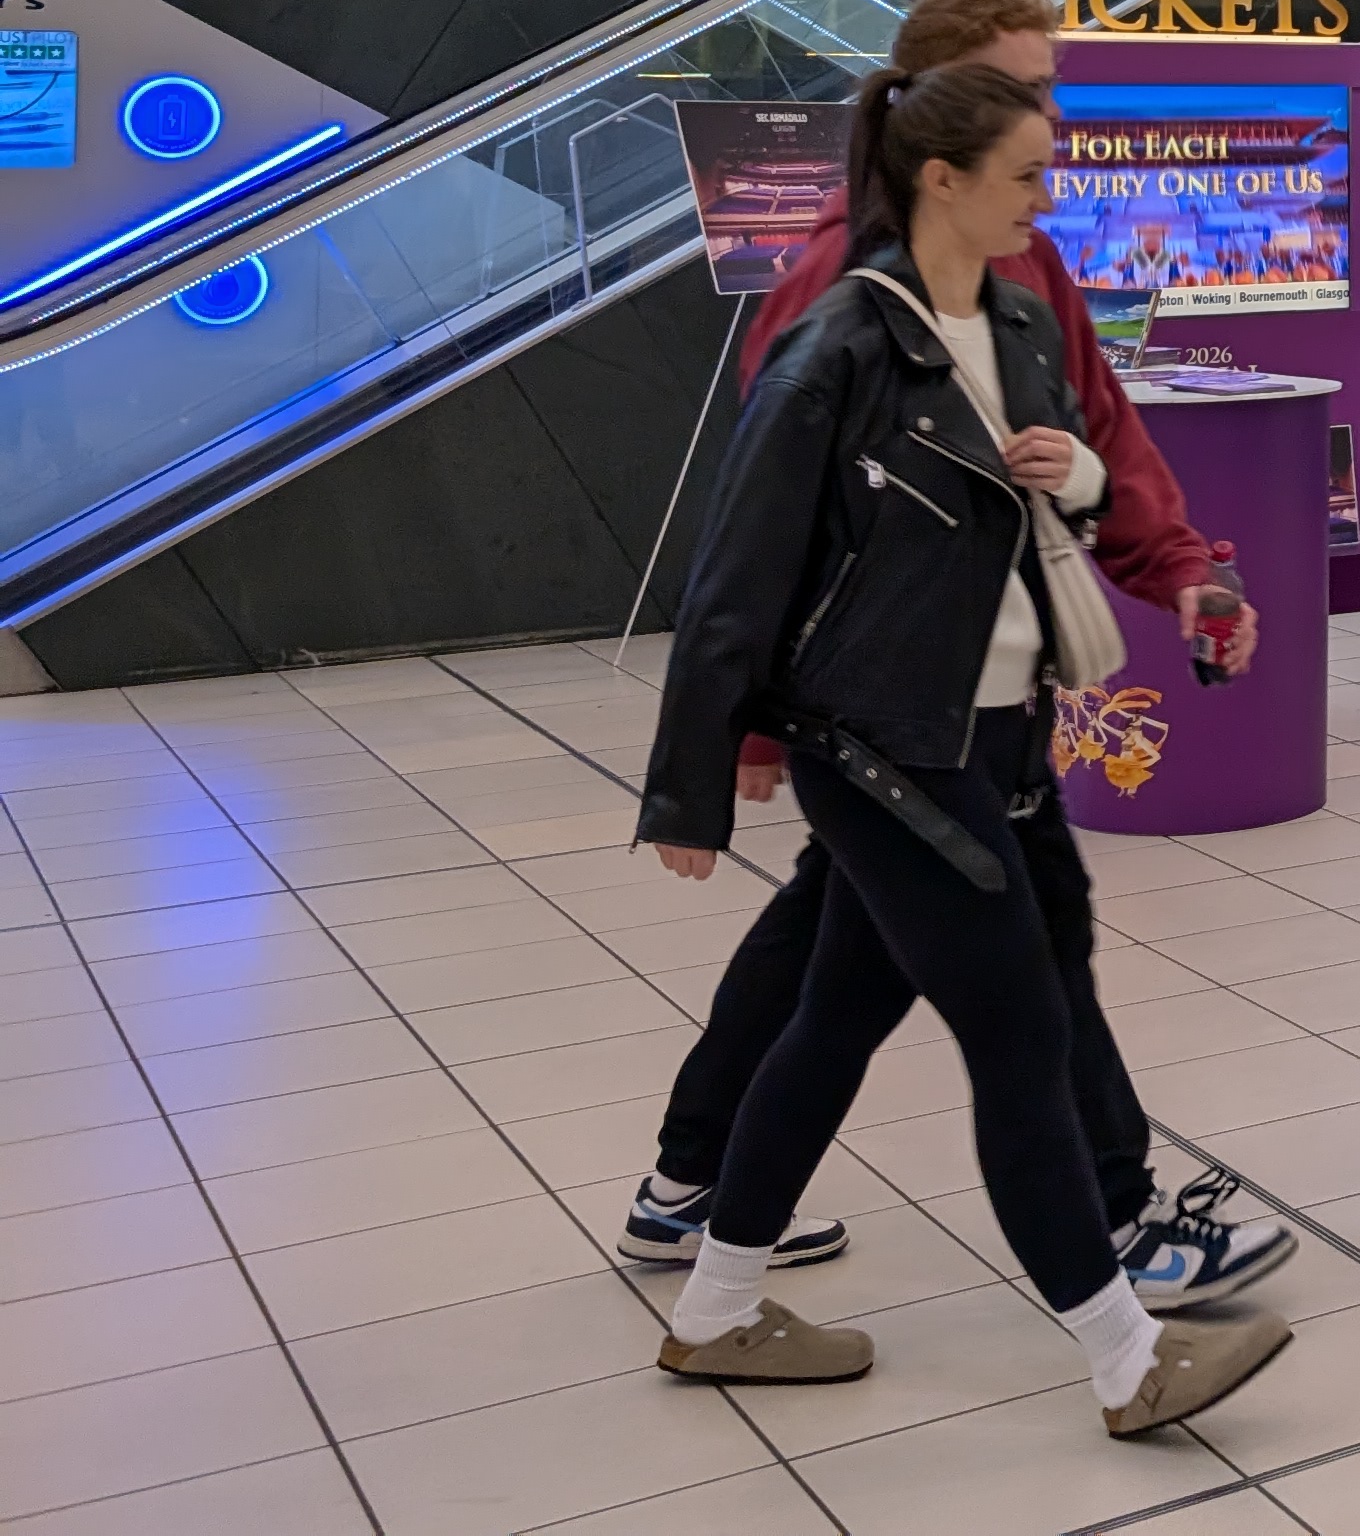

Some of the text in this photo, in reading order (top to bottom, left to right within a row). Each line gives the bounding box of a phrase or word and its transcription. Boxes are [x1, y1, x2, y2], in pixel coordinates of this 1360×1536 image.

[1191, 293, 1232, 306] Woking
[1239, 288, 1309, 303] Bournemouth
[1185, 346, 1234, 365] 2026
